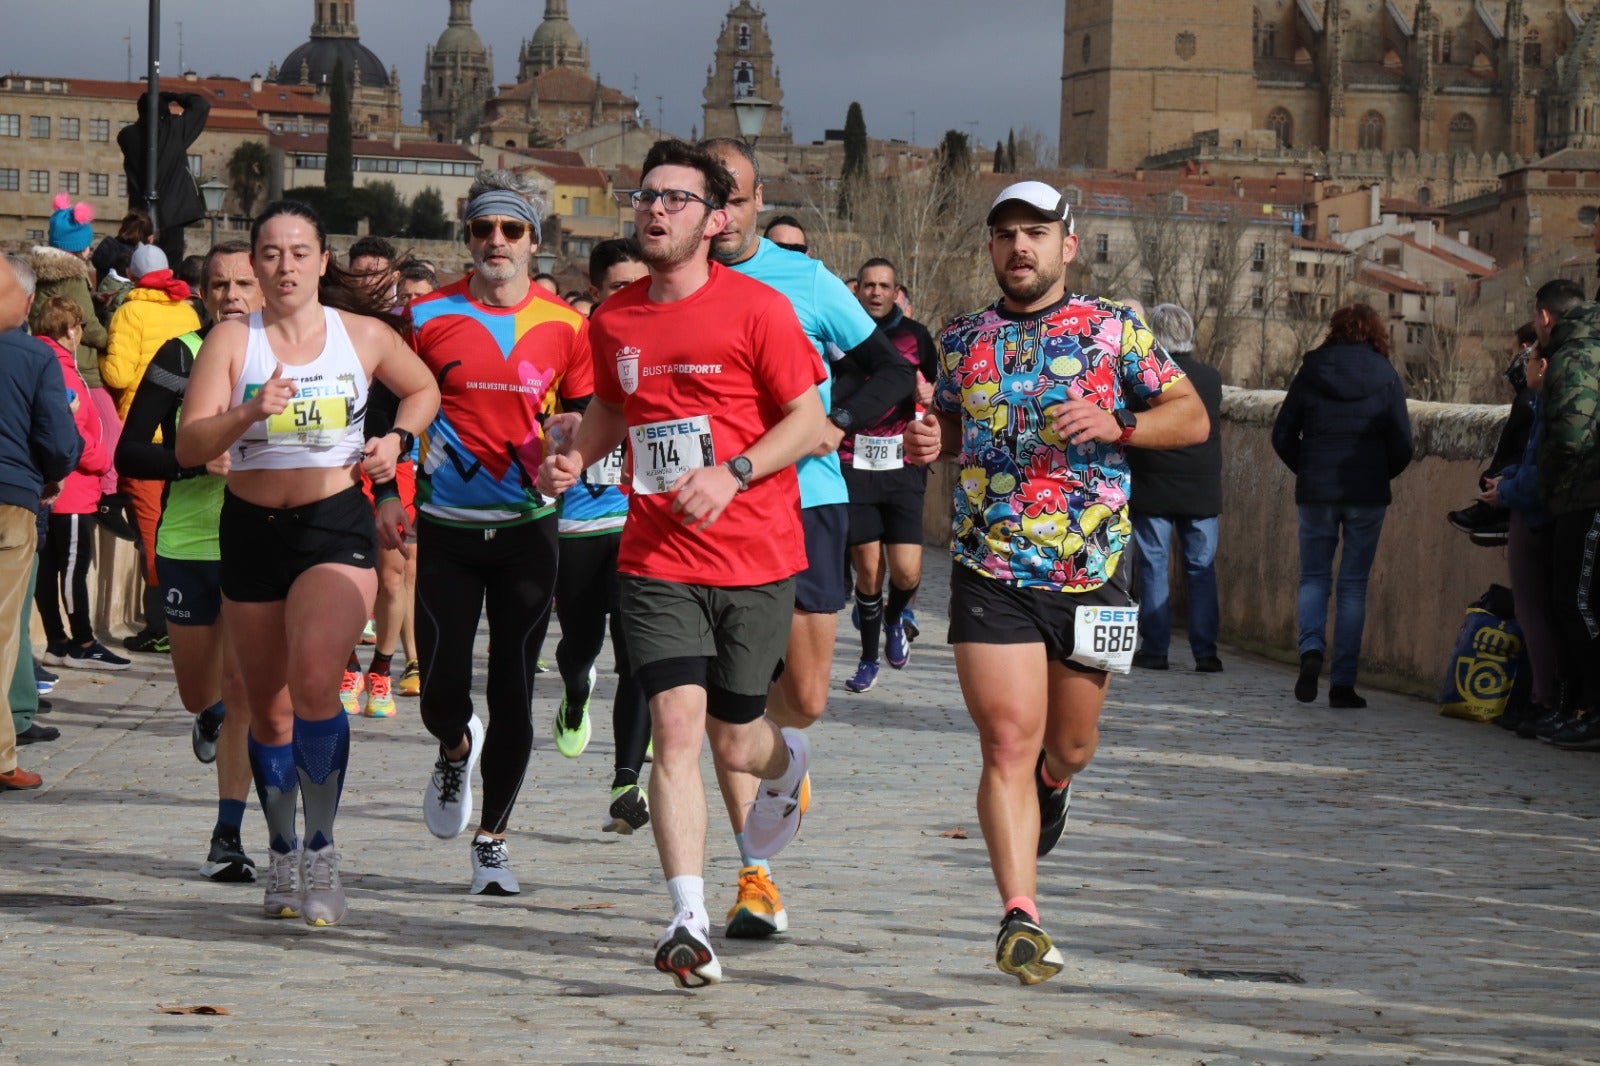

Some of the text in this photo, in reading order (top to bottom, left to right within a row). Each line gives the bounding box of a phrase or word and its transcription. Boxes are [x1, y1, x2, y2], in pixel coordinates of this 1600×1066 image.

[466, 381, 478, 389] SAN
[479, 382, 508, 391] SILVESTRE
[293, 400, 322, 427] 54
[646, 421, 701, 440] SETEL
[648, 439, 680, 470] 714
[865, 445, 888, 460] 378
[1100, 610, 1138, 623] SET
[1093, 624, 1135, 653] 686
